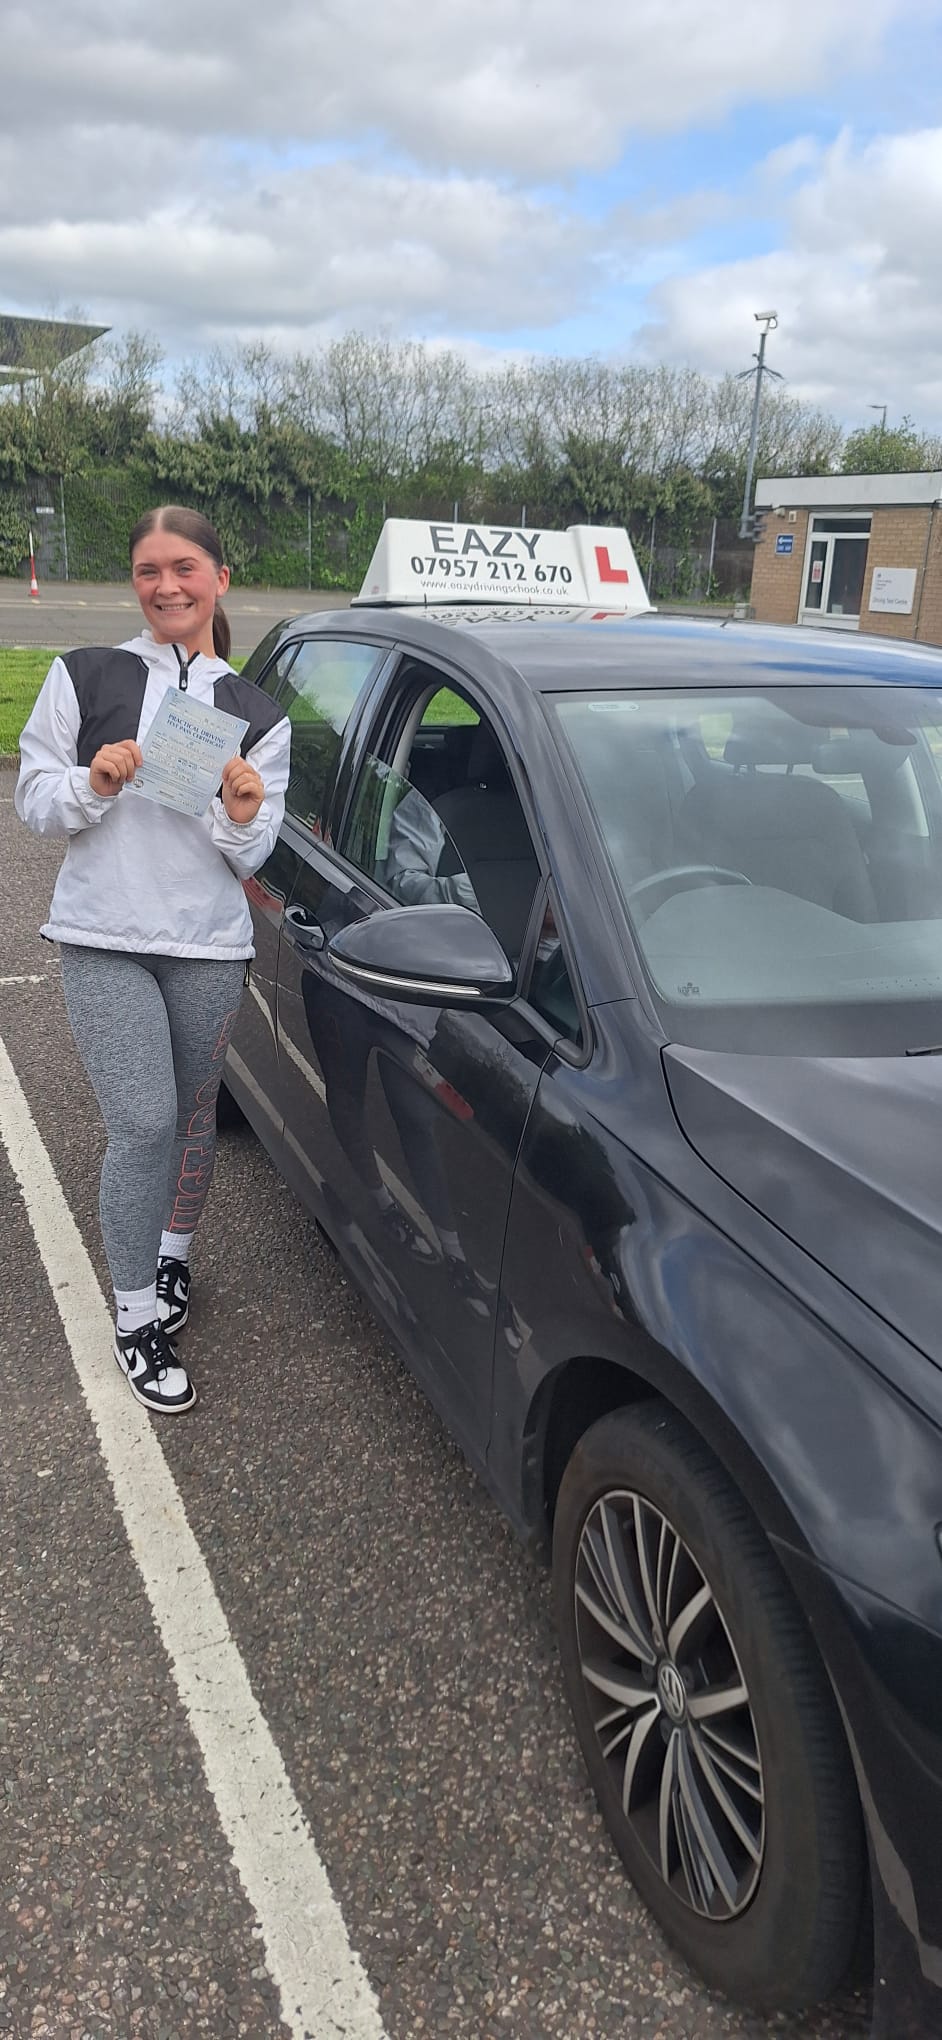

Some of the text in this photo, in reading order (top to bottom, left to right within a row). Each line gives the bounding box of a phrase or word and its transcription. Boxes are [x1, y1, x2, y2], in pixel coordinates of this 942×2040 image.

[429, 526, 541, 560] EAZY
[410, 556, 573, 584] 07957 212 670
[594, 546, 629, 584] L
[420, 580, 569, 596] www.eazydrivingschool.co.uk
[168, 713, 199, 733] PRACTICAL
[200, 727, 226, 745] DRIVING
